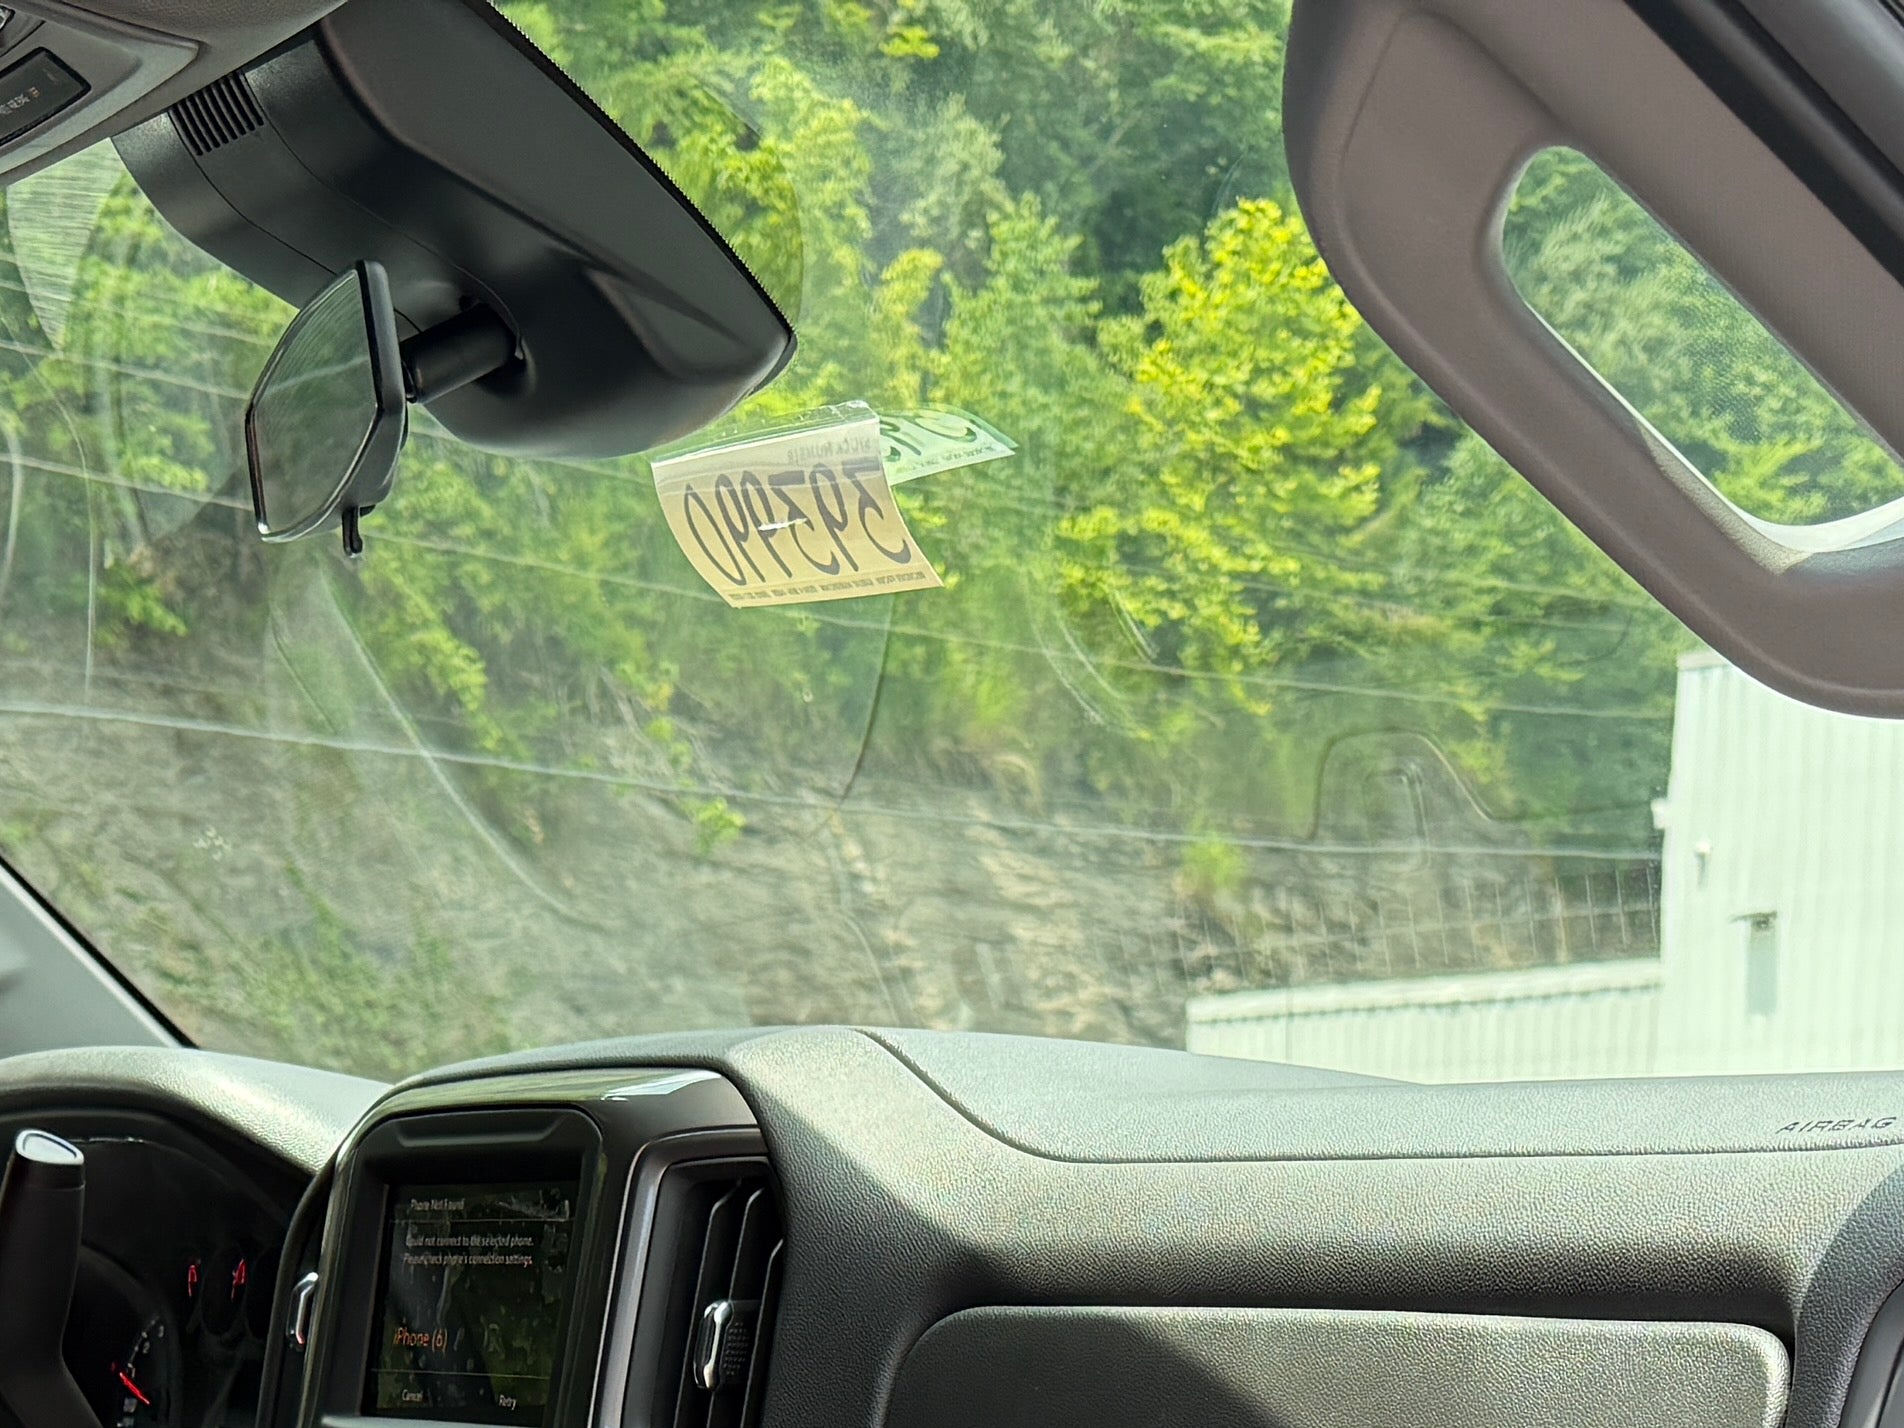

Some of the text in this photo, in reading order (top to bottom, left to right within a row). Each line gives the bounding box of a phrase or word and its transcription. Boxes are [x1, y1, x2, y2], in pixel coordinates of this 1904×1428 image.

[1775, 1117, 1897, 1134] AIRBAG
[393, 1327, 447, 1353] iPhone (6)
[402, 1389, 424, 1401] Cancel
[499, 1394, 517, 1410] Retry
